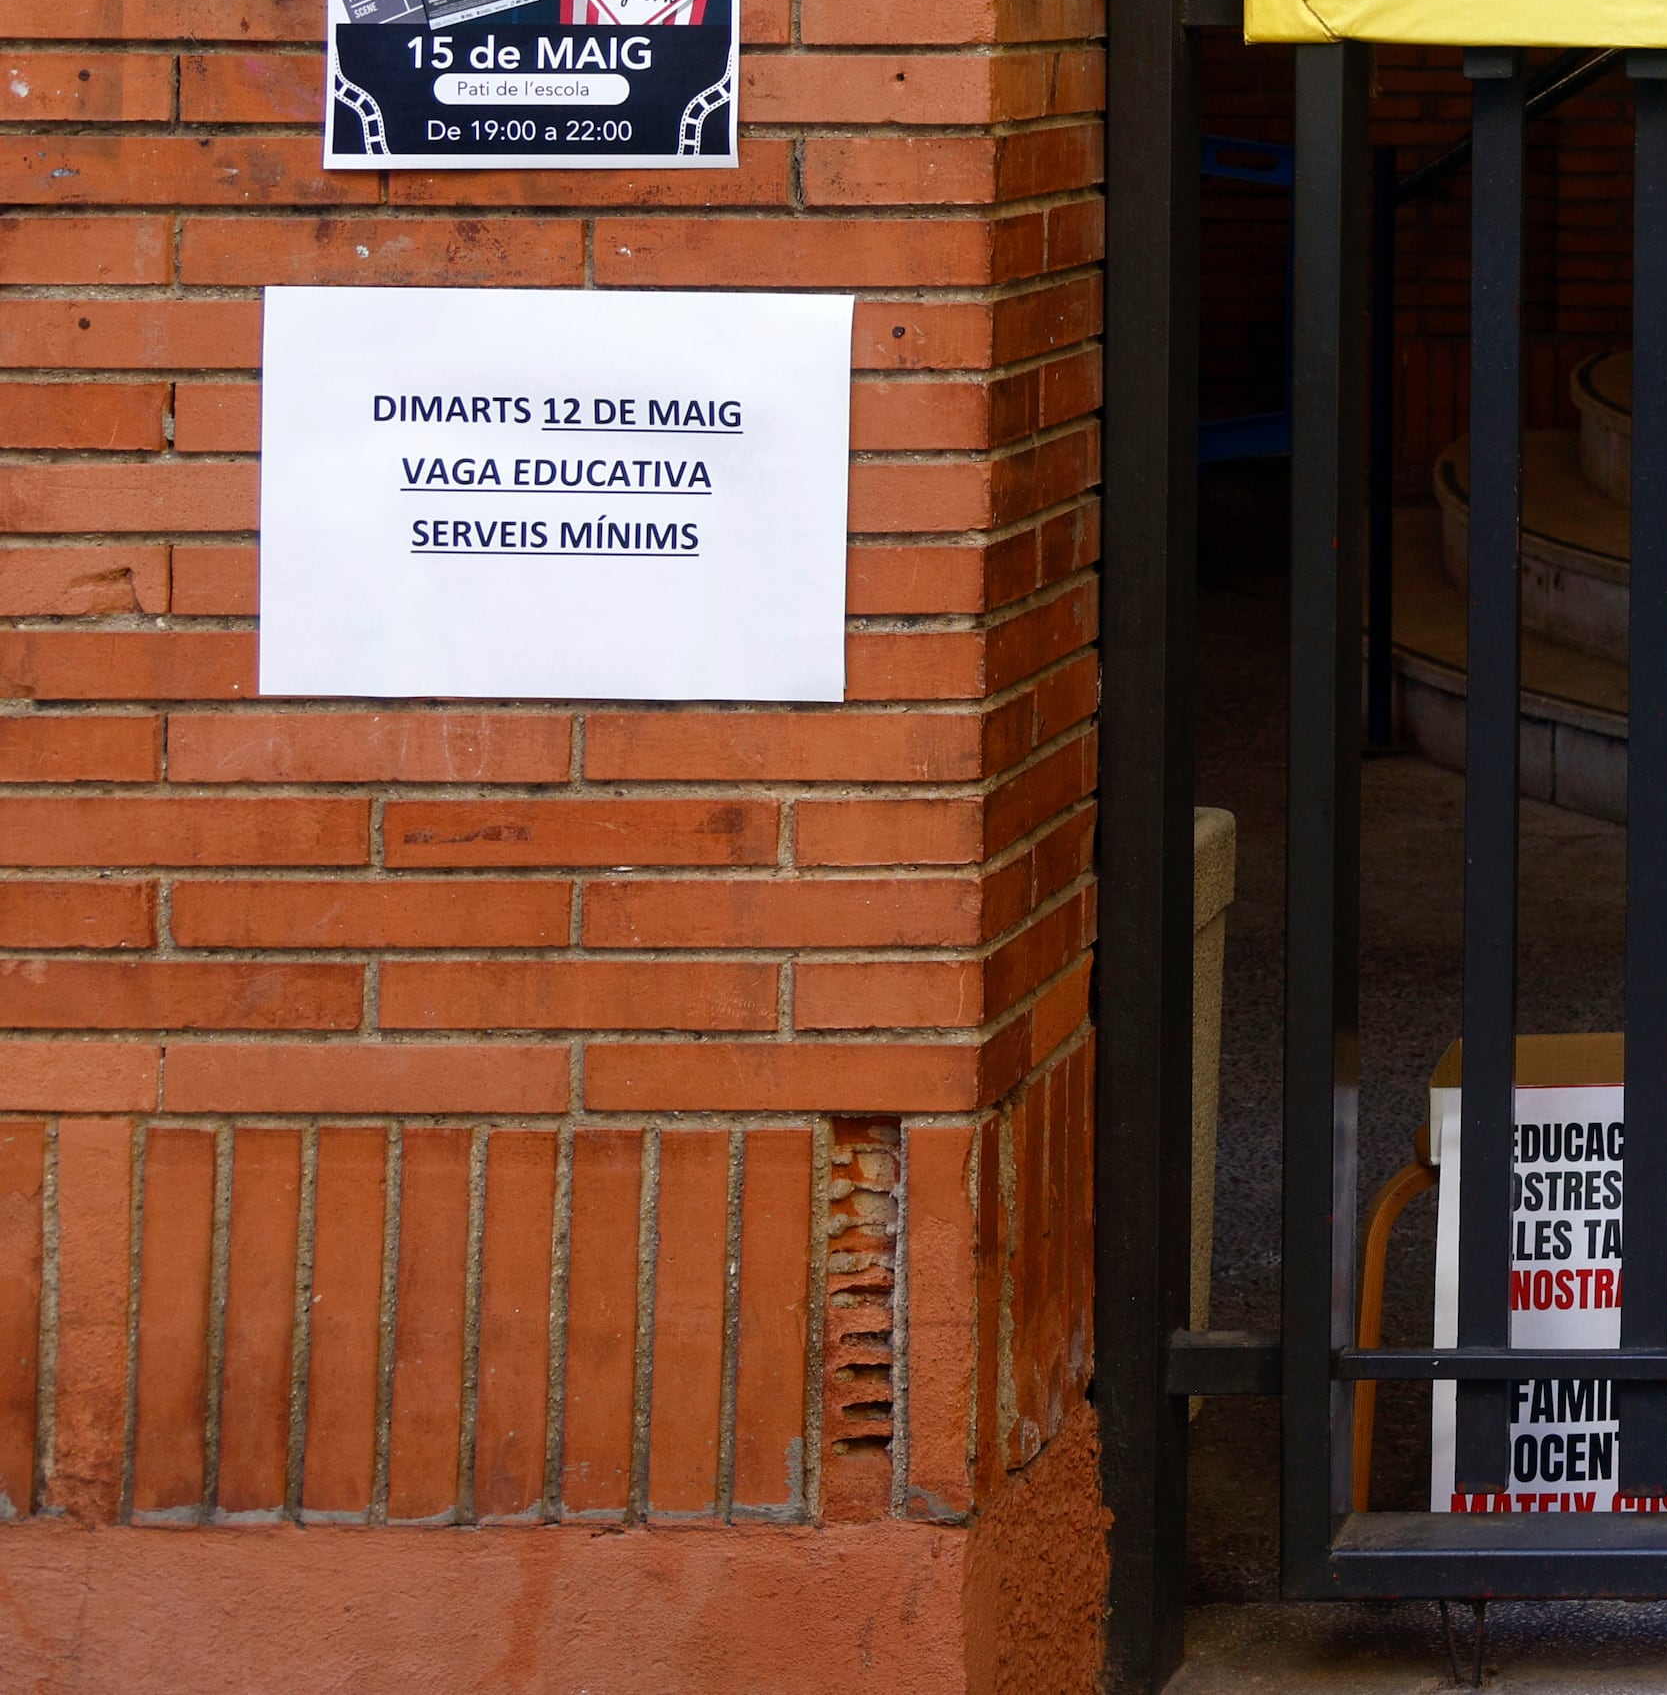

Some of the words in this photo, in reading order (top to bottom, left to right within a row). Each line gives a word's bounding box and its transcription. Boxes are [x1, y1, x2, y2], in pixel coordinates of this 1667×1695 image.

[354, 2, 378, 18] SCENE
[407, 36, 454, 70] 15
[470, 37, 521, 70] de
[538, 37, 652, 70] MAIG
[457, 81, 491, 97] Pati
[496, 81, 518, 97] de
[524, 81, 590, 97] l'escola
[428, 120, 461, 141] De
[470, 120, 536, 141] 19:00
[544, 127, 557, 141] a
[566, 120, 633, 141] 22:00
[374, 395, 531, 423] DIMARTS
[543, 398, 581, 425] 12
[593, 399, 636, 426] DE
[648, 400, 742, 428] MAIG
[402, 457, 500, 486] VAGA
[513, 459, 712, 489] EDUCATIVA
[411, 520, 548, 549] SERVEIS
[560, 515, 699, 550] MÍNIMS
